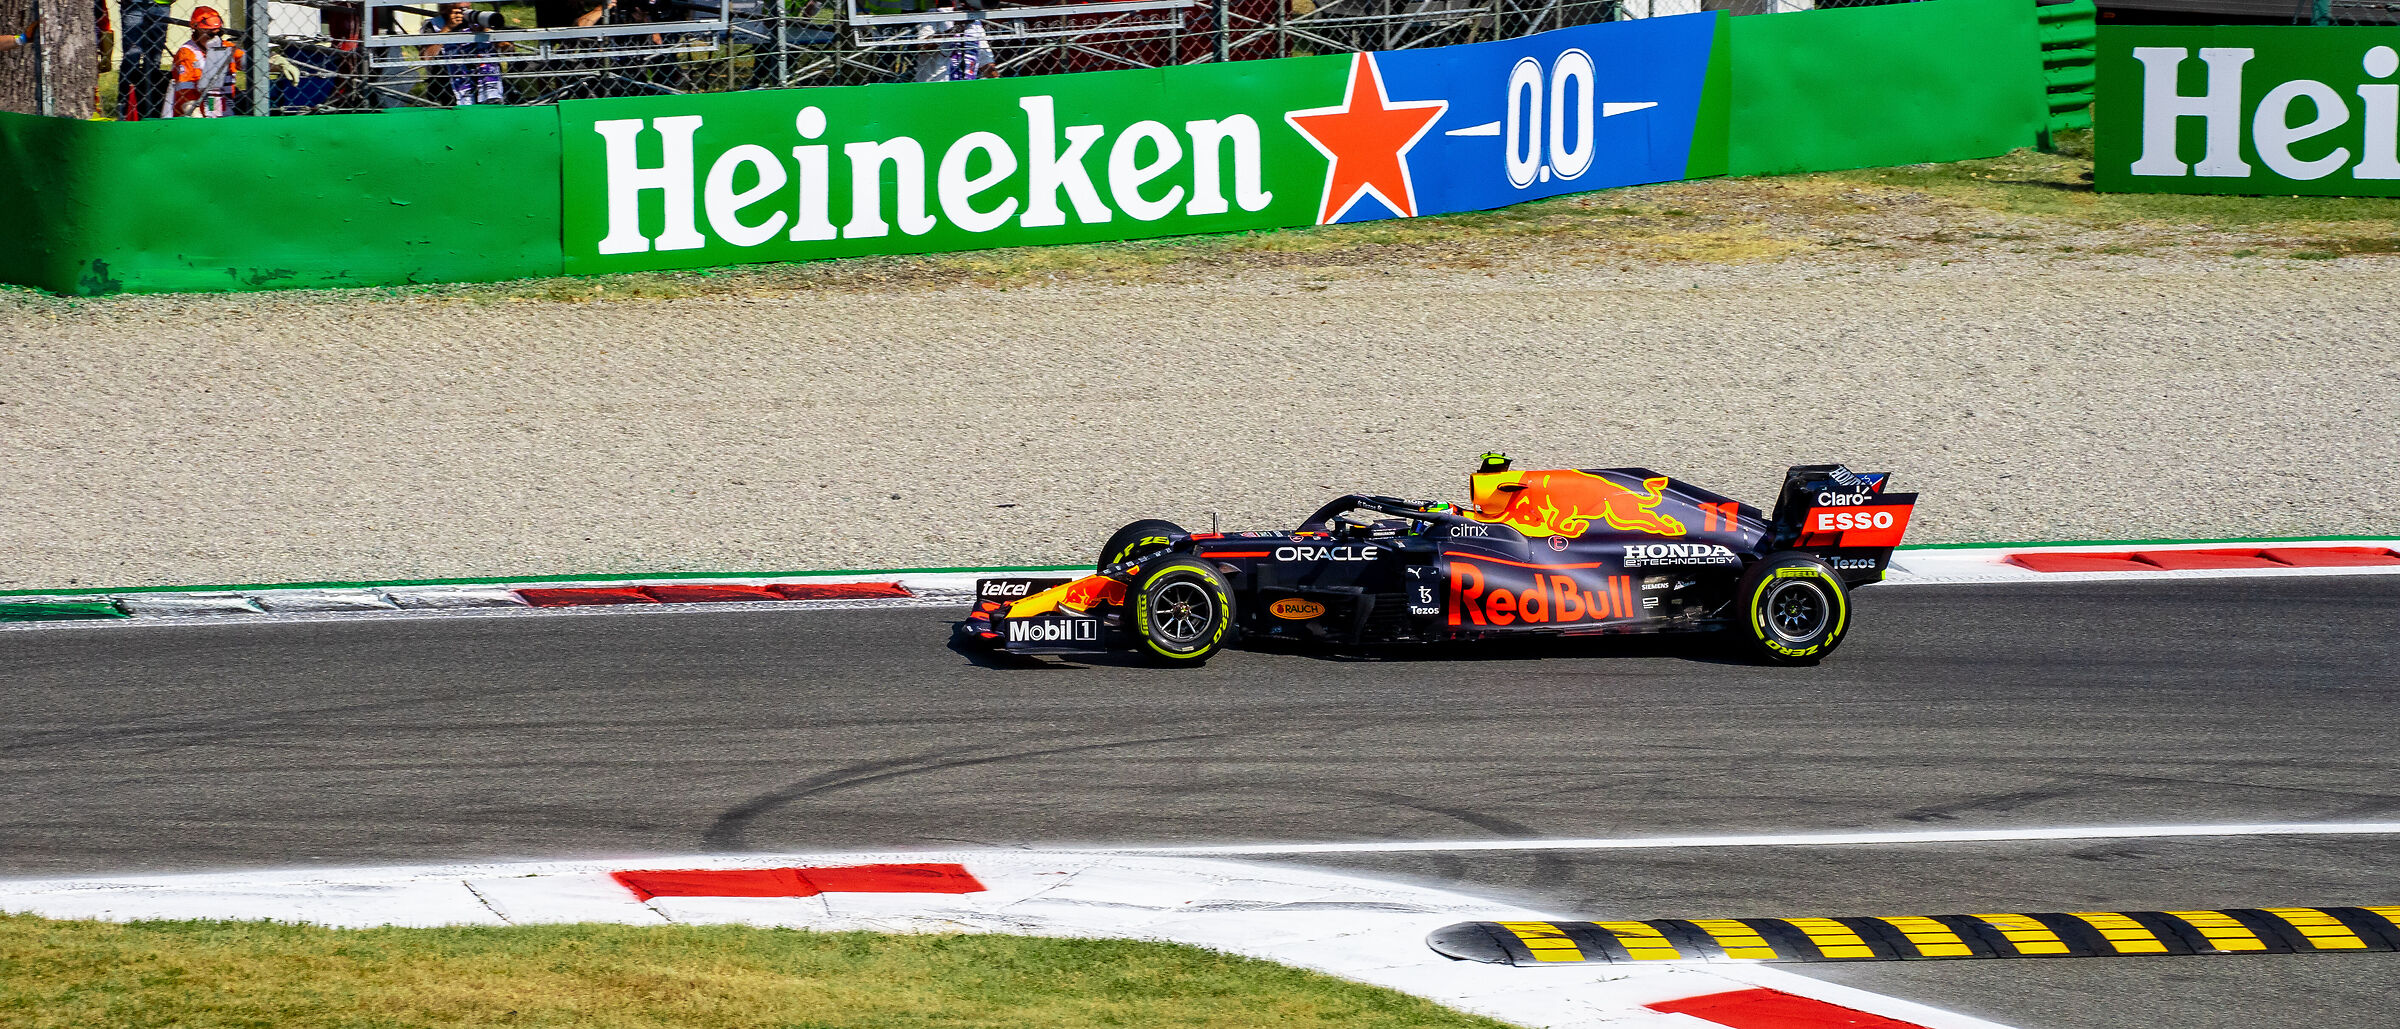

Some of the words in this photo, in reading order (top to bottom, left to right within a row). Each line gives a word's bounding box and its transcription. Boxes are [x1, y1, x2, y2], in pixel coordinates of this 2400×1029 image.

[1505, 48, 1597, 190] 0.0
[594, 95, 1272, 255] Heineken
[1818, 491, 1864, 507] Claro
[1697, 502, 1740, 532] 11
[1818, 511, 1893, 531] ESSO
[1450, 523, 1489, 537] citrix
[1275, 546, 1378, 562] ORACLE
[1623, 543, 1735, 559] HONDA
[1830, 556, 1876, 570] Tezos
[1776, 567, 1820, 578] PIRELLI
[981, 580, 1032, 596] telcel
[1641, 582, 1670, 591] SIEMENS
[1137, 594, 1150, 637] PIRELLI
[1285, 603, 1319, 614] RAUCH
[1411, 605, 1440, 616] Tezos
[1213, 591, 1230, 645] ZERO
[1009, 619, 1072, 642] Mobil
[1765, 639, 1819, 657] ZERO
